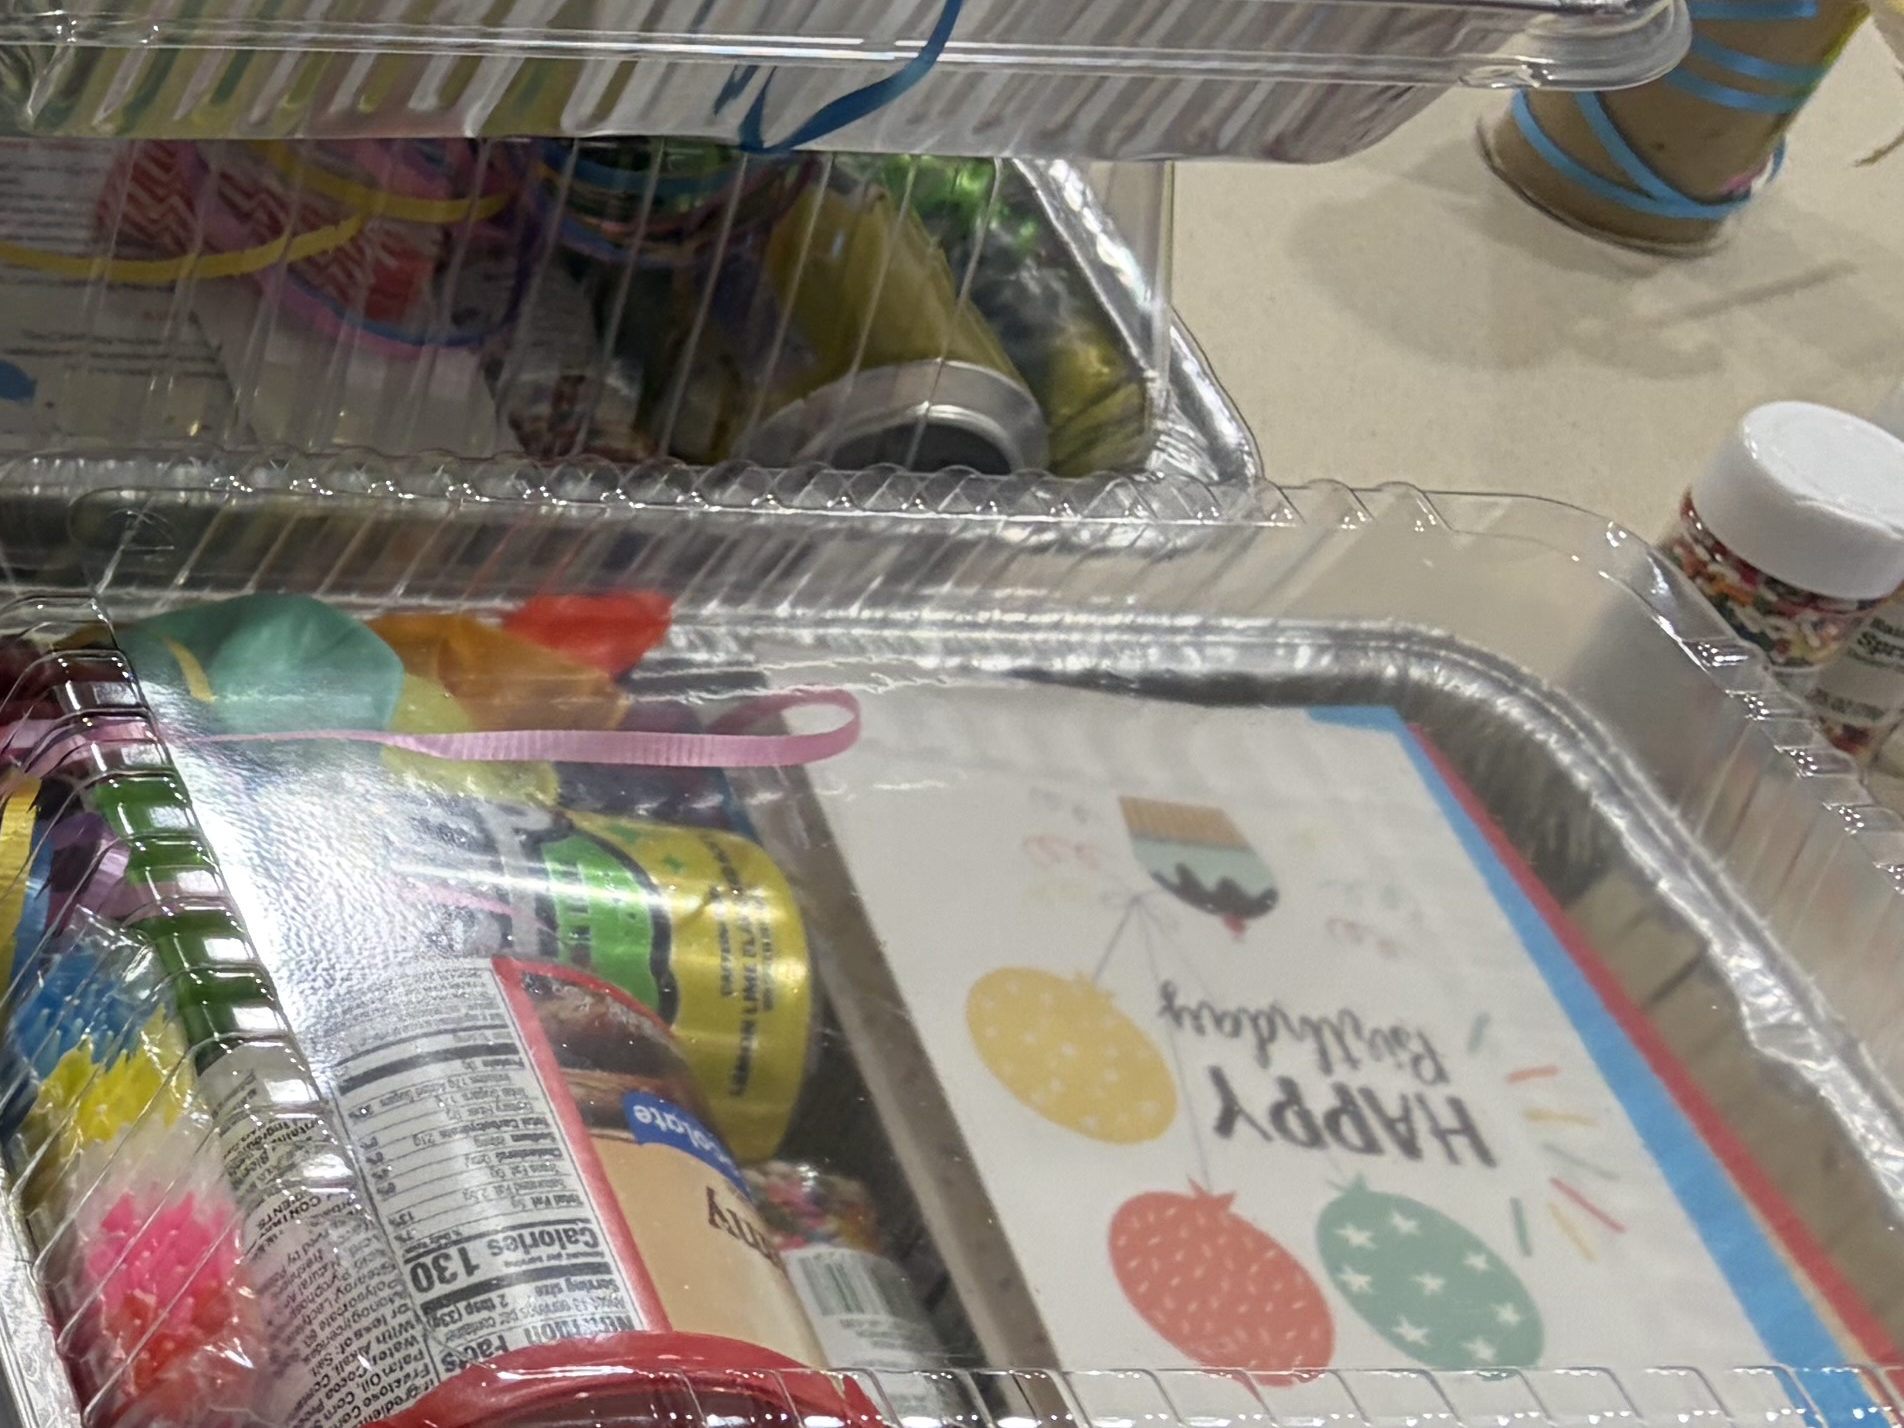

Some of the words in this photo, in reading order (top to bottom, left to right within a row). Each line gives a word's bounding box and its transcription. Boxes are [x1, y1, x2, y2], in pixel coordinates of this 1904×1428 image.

[1156, 976, 1446, 1084] Birthday
[1210, 1068, 1498, 1169] HAPPY
[486, 1226, 600, 1257] Calories
[409, 1246, 480, 1293] 130
[567, 1276, 620, 1293] Serving
[464, 1297, 496, 1319] tbsp
